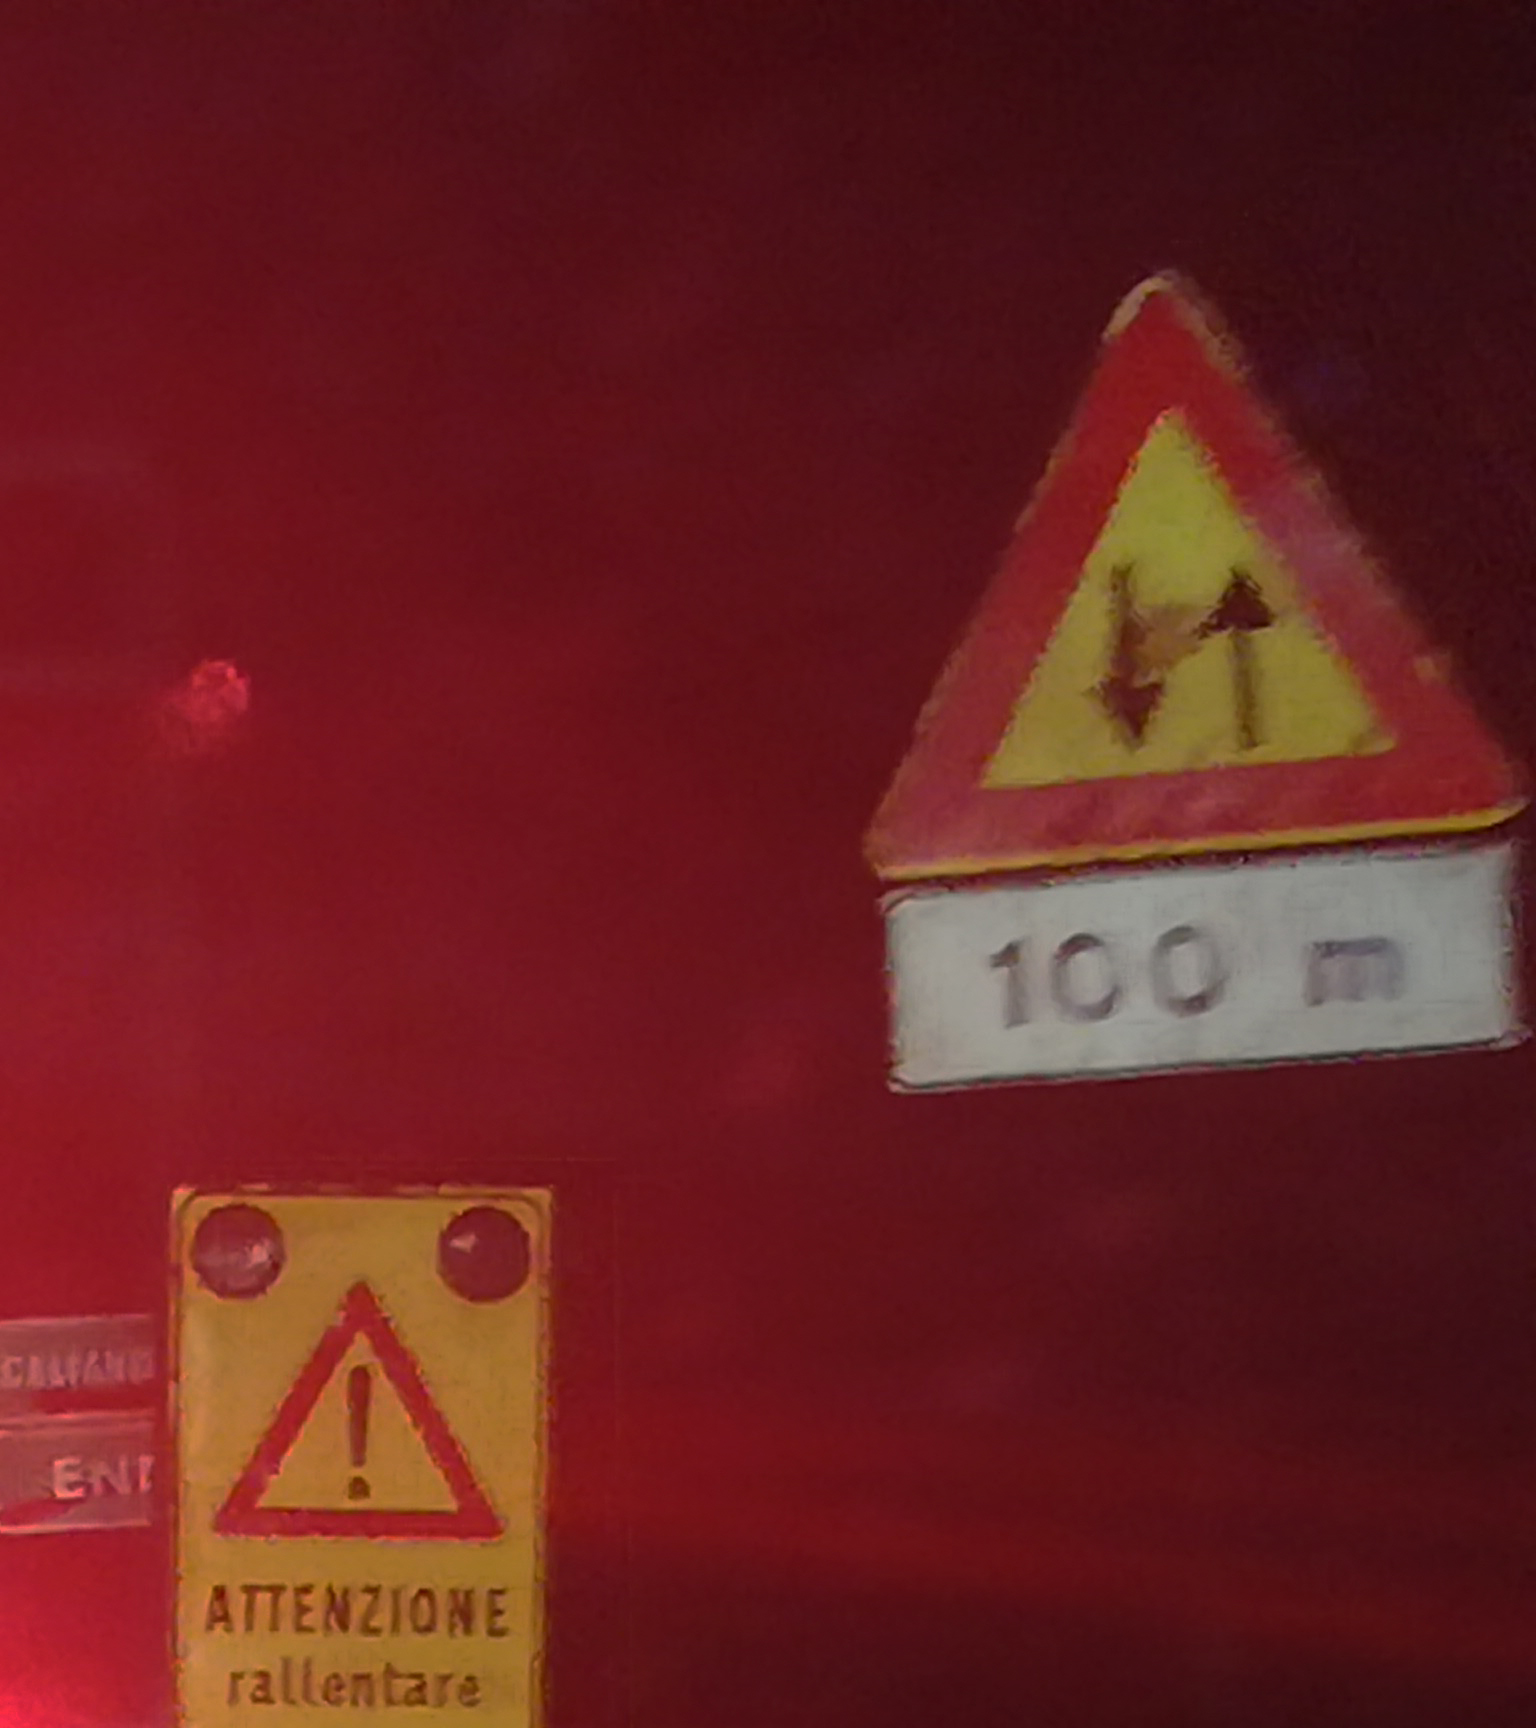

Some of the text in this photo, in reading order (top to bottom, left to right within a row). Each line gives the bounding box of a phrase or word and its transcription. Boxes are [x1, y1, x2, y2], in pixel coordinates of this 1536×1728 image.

[987, 925, 1404, 1028] 100 m
[205, 1584, 510, 1639] ATTENZIONE
[227, 1657, 482, 1708] rallentare
